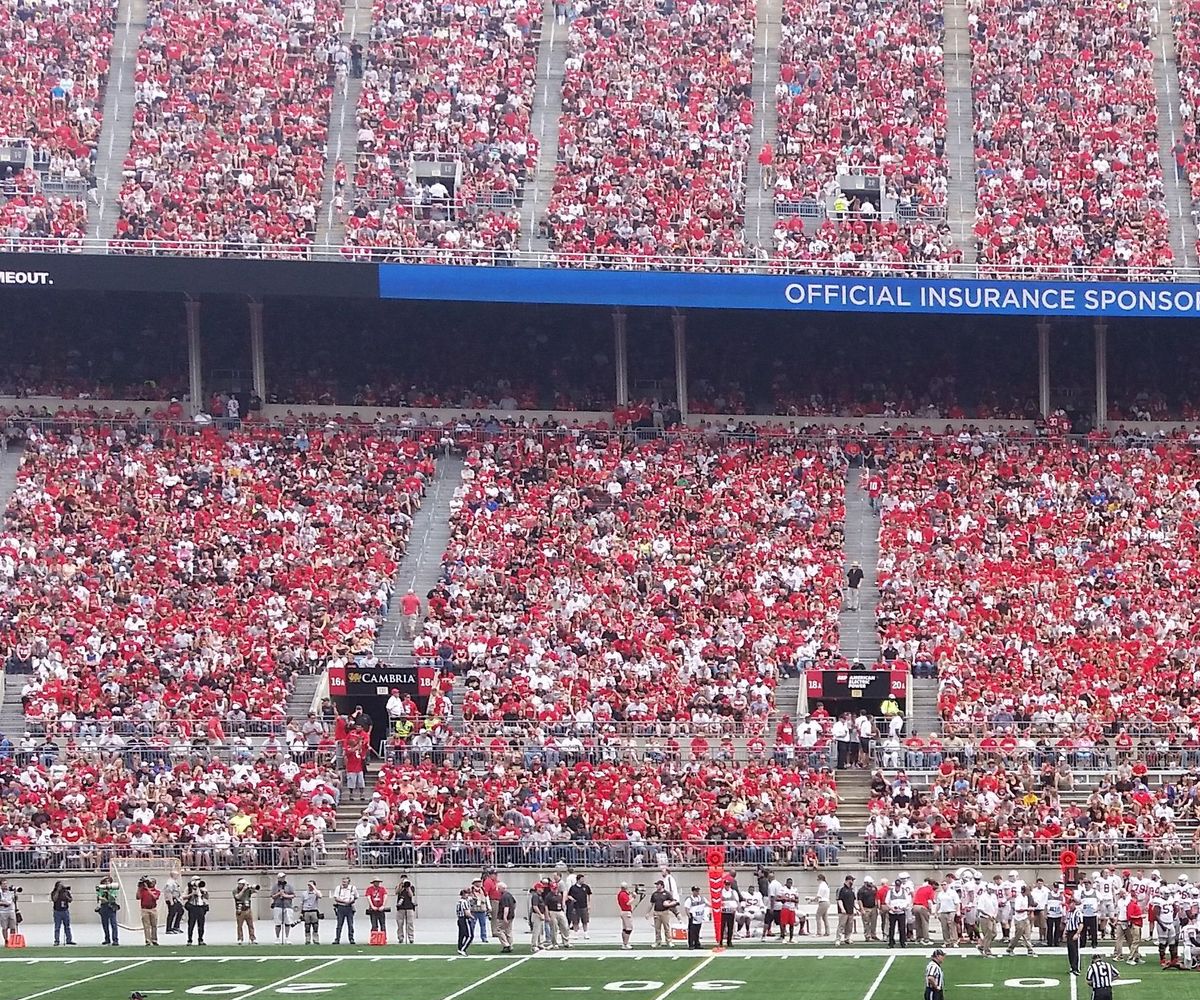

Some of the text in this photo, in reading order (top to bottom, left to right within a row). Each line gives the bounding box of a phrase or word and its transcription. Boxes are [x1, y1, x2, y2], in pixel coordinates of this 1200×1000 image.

[784, 283, 911, 306] OFFICIAL
[920, 287, 1075, 309] INSURANCE
[362, 673, 416, 684] CAMBRIA
[1100, 963, 1108, 977] C
